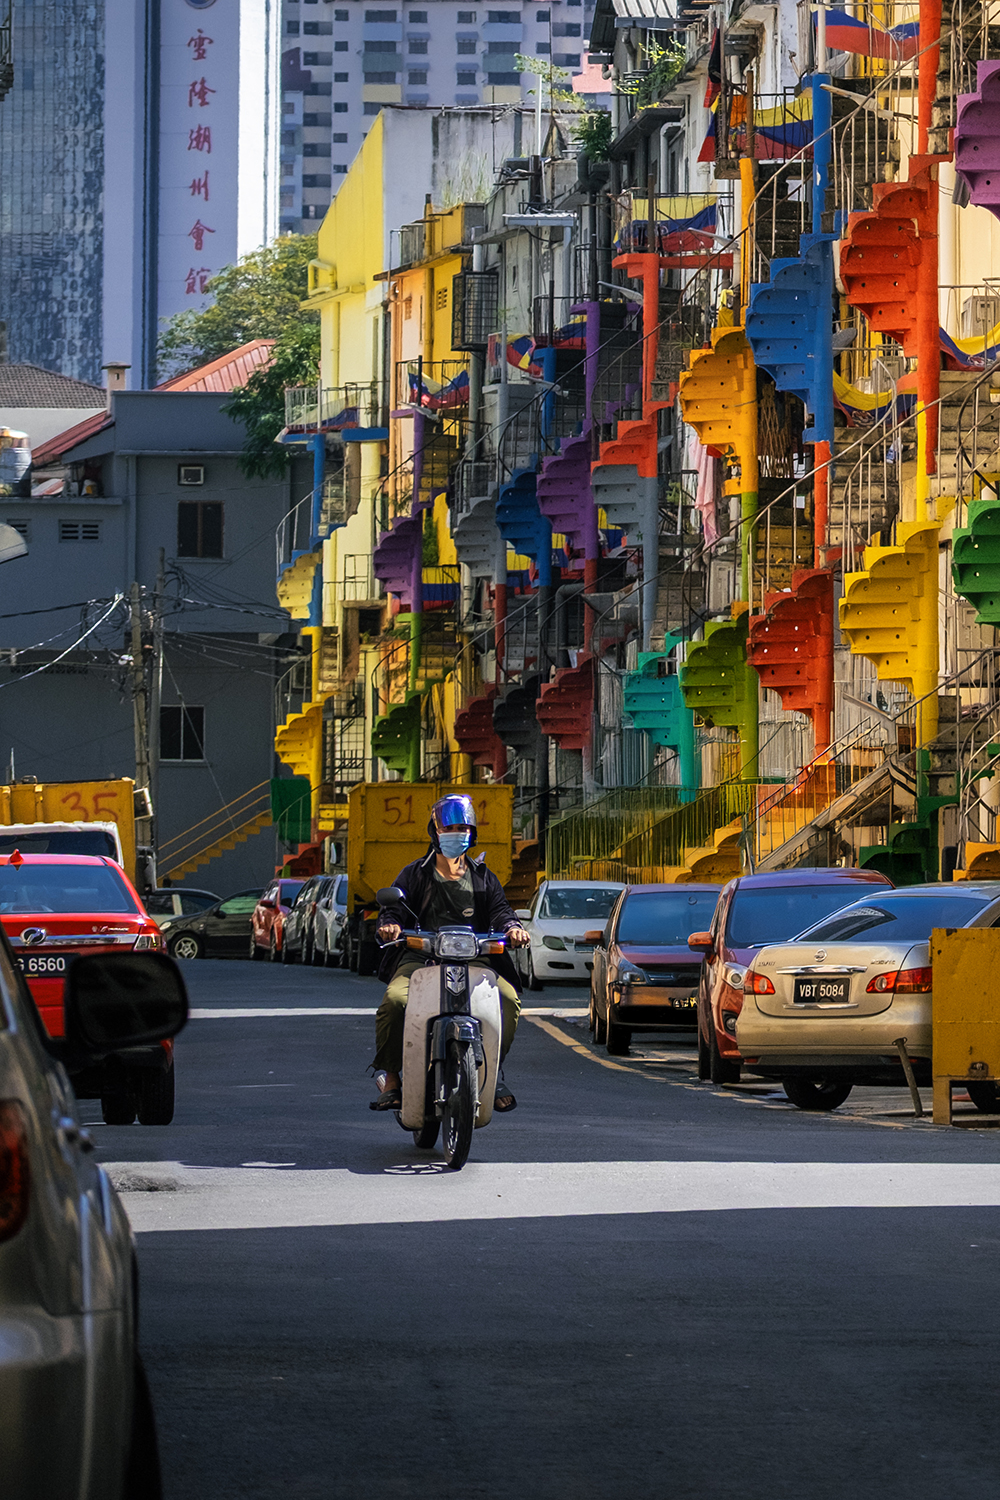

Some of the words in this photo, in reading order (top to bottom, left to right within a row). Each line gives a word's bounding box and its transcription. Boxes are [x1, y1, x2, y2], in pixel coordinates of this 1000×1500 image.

[383, 794, 416, 826] 51
[28, 957, 66, 972] 6560
[800, 984, 817, 997] VBT
[819, 985, 844, 997] 5084
